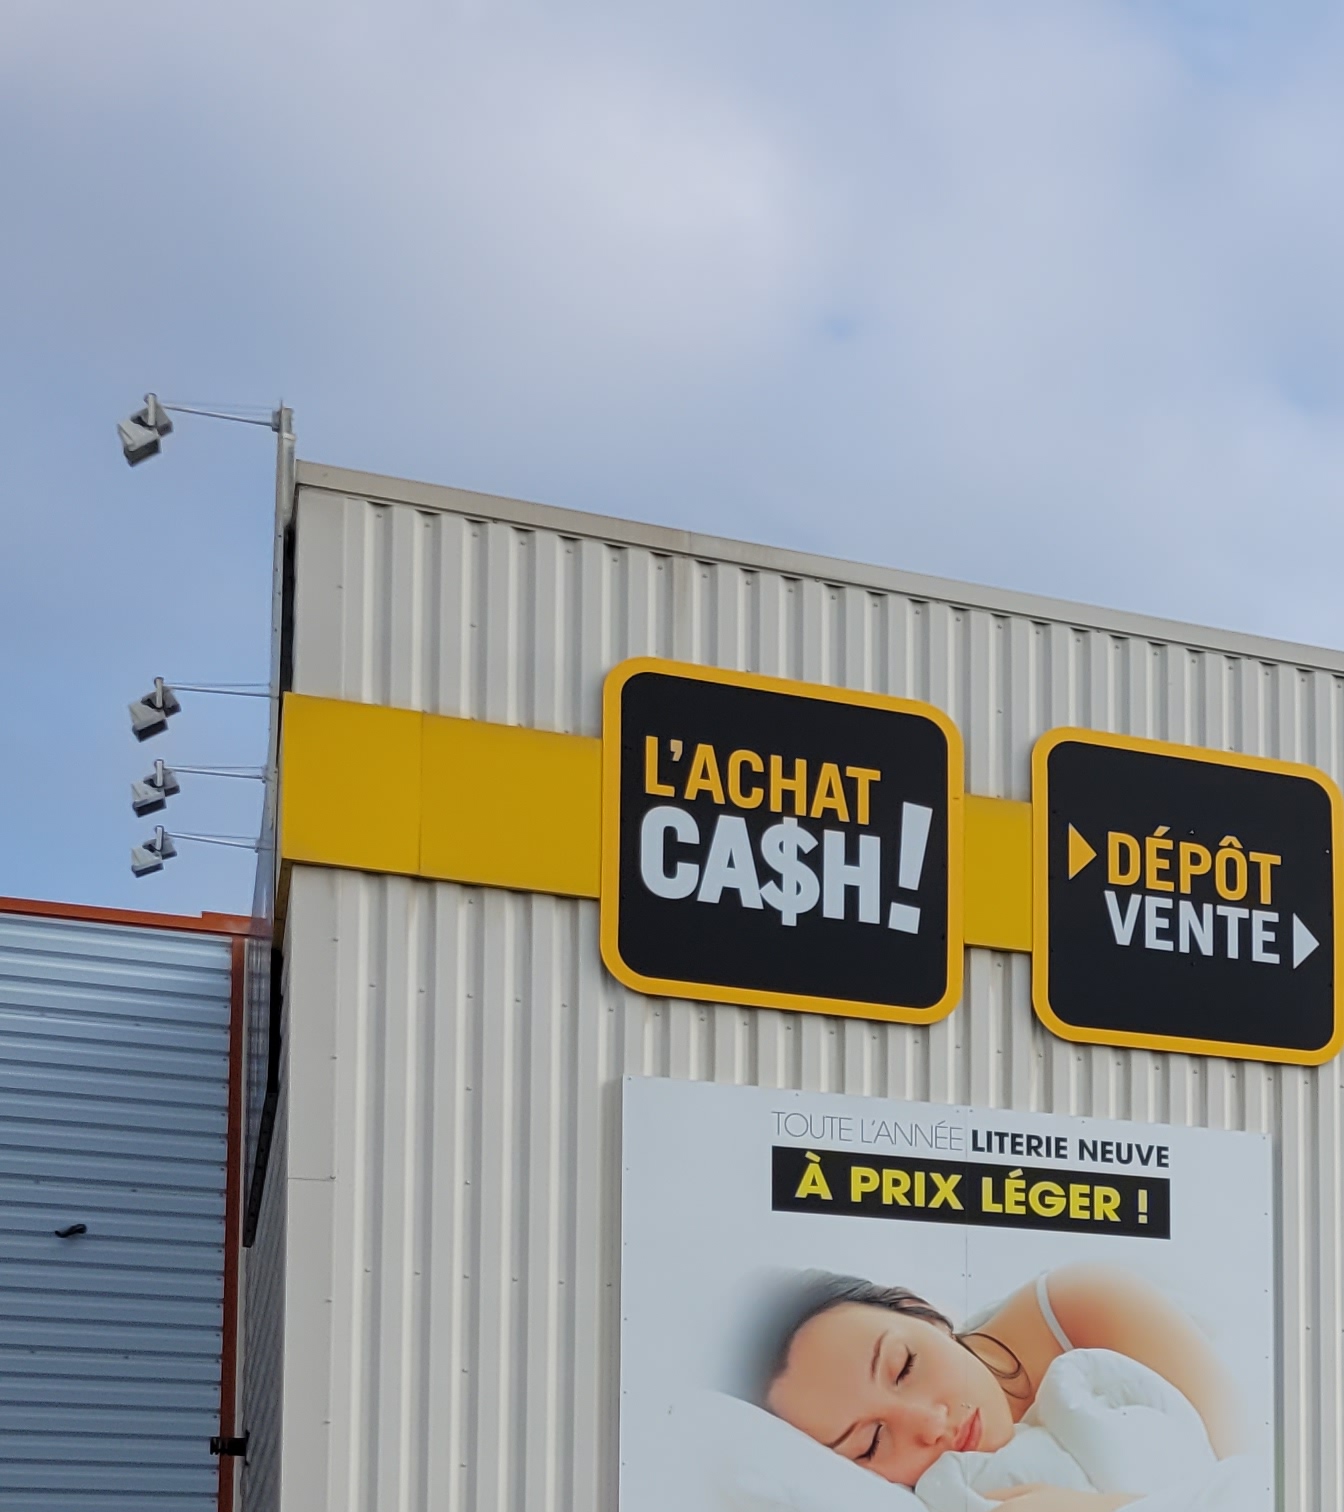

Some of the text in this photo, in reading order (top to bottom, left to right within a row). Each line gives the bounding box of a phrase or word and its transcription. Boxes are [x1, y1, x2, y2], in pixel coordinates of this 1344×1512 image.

[644, 736, 882, 825] L'ACHAT
[639, 801, 934, 935] CA$H!
[1107, 825, 1282, 906] DÉPÔT
[1104, 890, 1281, 966] VENTE
[771, 1110, 1170, 1169] TOUTE L'ANNÉE LITERIE NEUVE
[795, 1151, 1149, 1224] À PRIX LÉGER !
